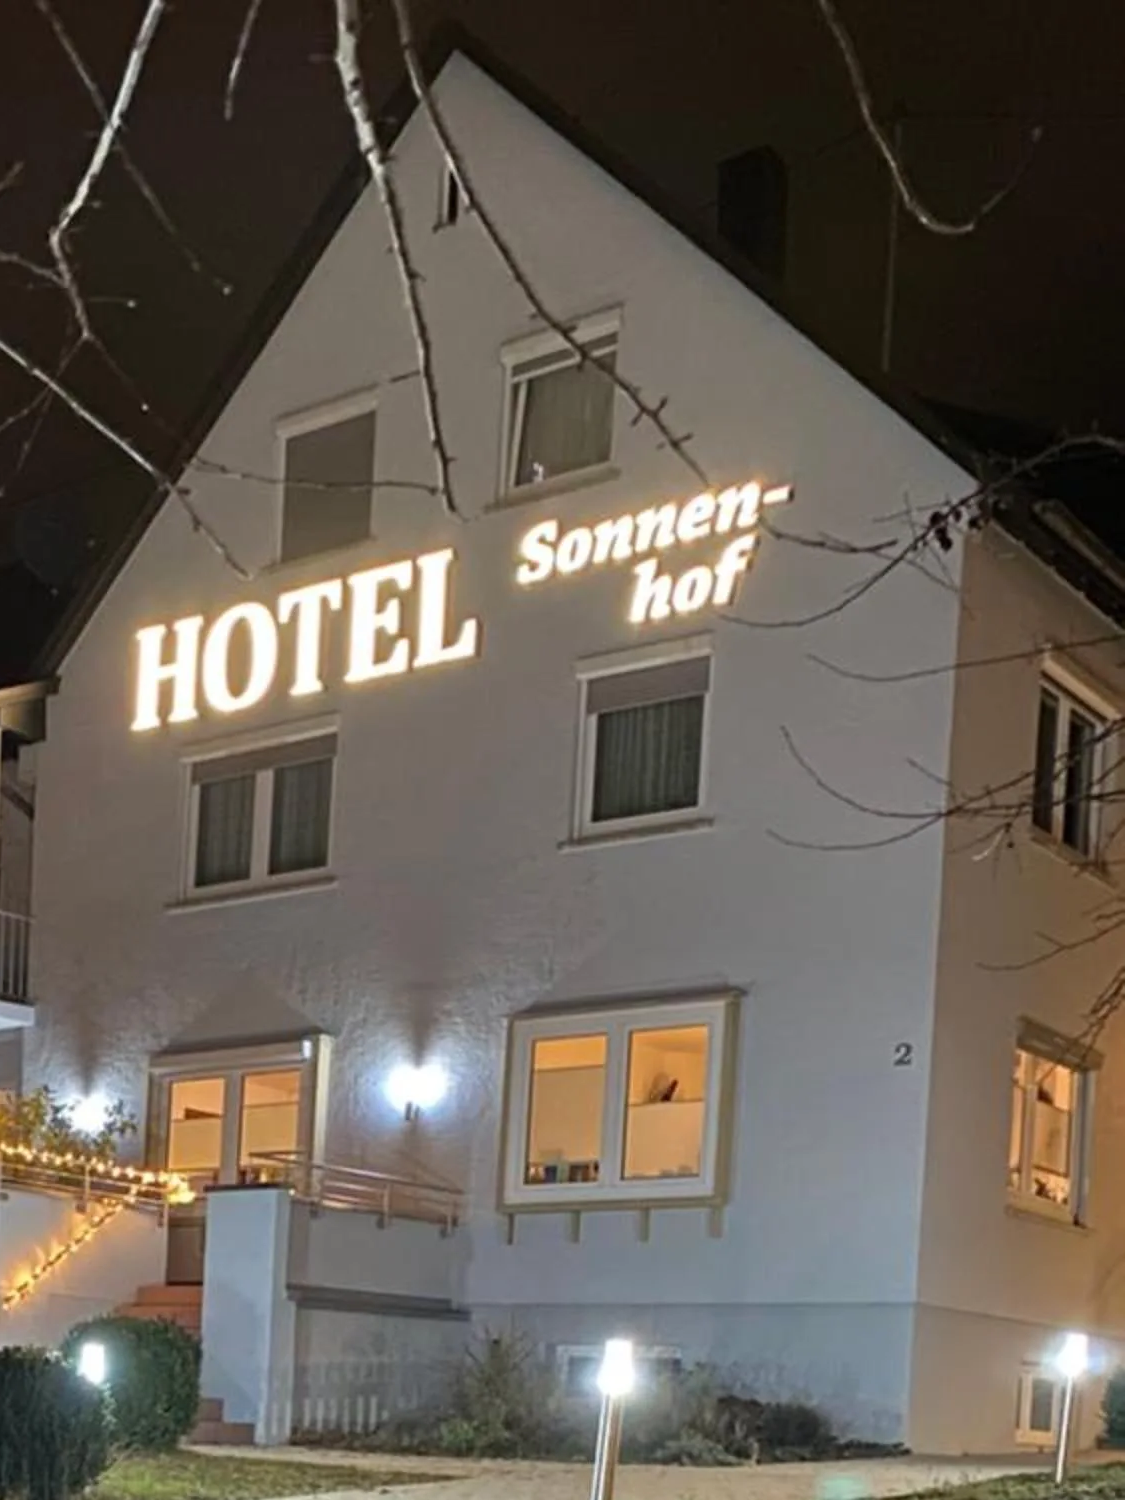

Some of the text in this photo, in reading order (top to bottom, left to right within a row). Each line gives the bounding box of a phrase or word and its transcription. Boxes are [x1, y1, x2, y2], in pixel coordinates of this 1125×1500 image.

[515, 477, 793, 585] Sonnen-
[627, 534, 761, 625] hof
[129, 547, 479, 734] HOTEL
[893, 1042, 913, 1067] 2
